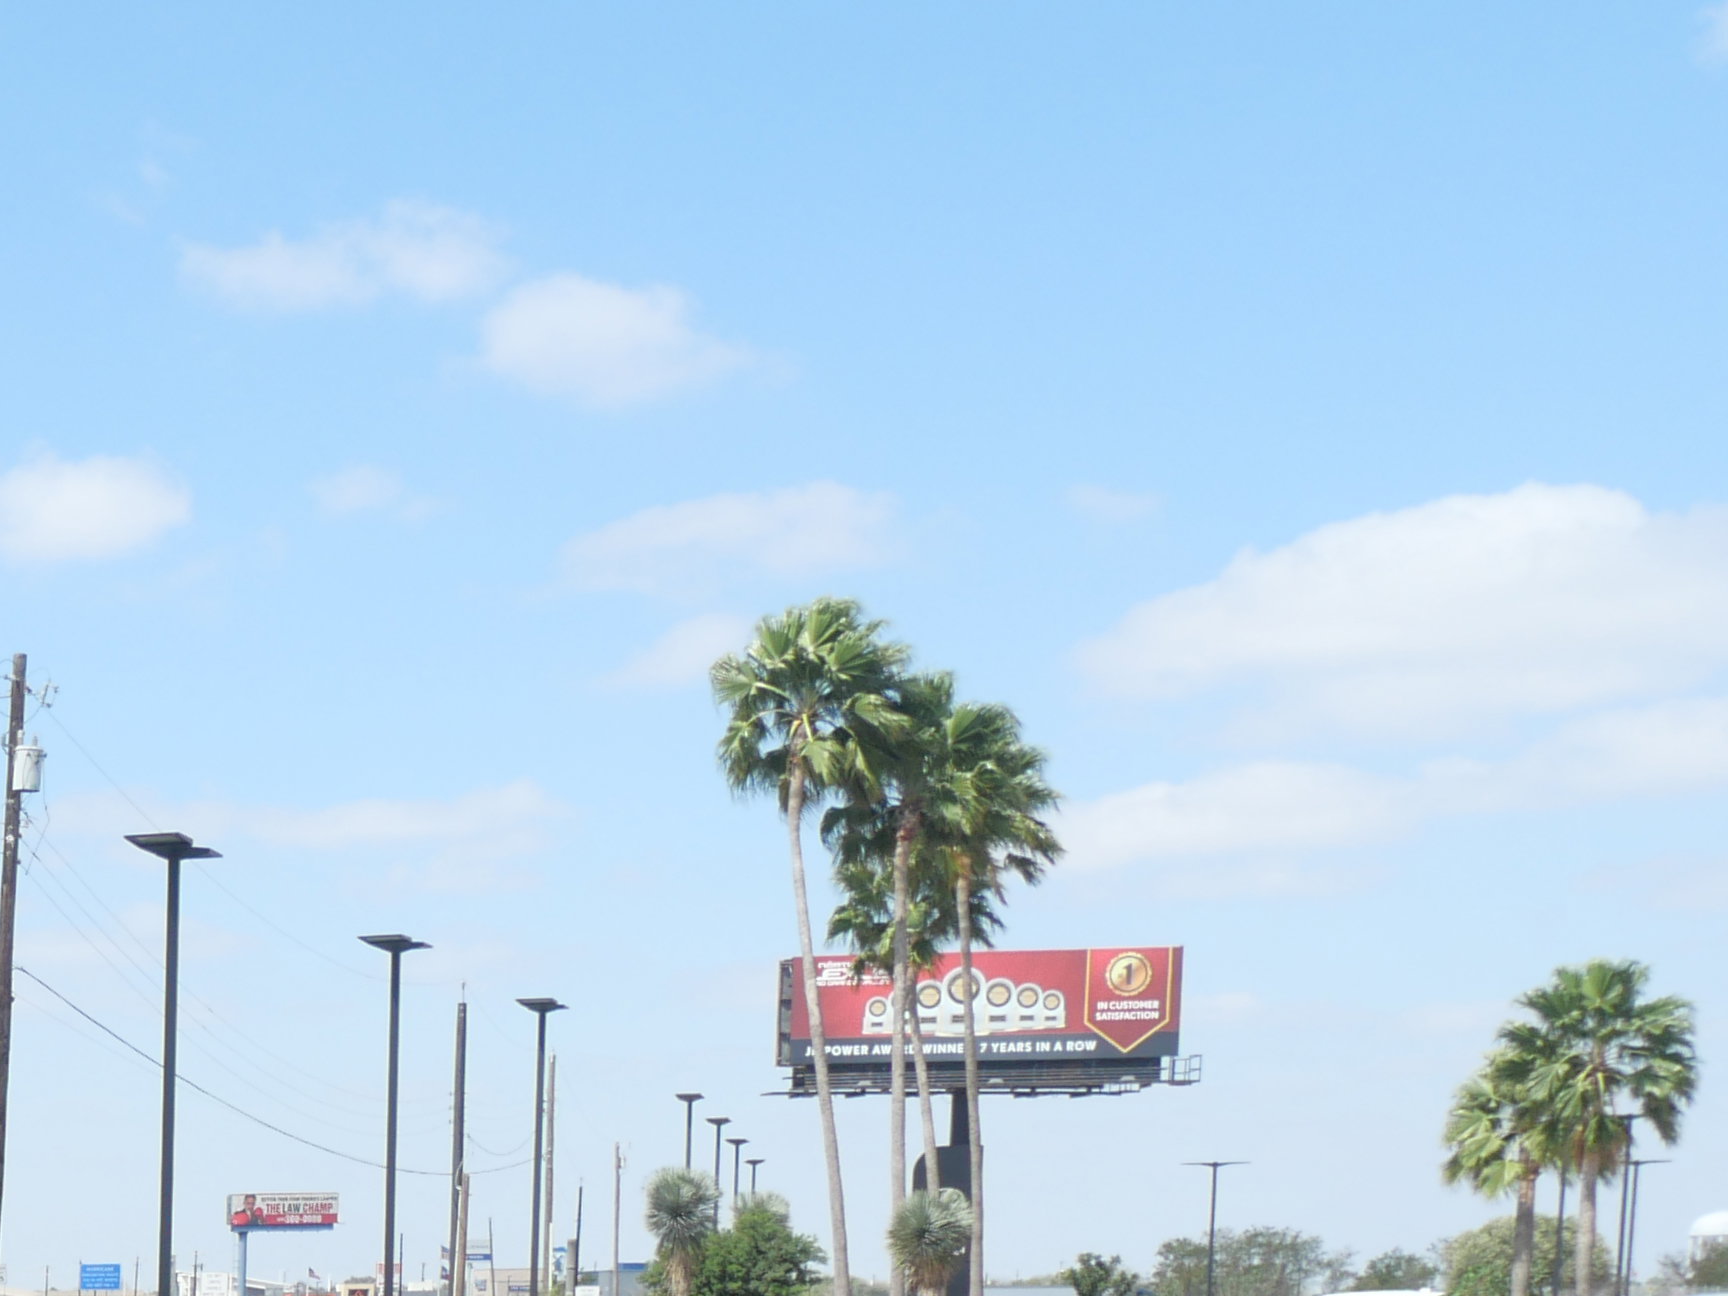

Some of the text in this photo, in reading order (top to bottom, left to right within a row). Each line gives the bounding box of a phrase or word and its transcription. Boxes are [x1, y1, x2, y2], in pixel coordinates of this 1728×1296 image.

[1097, 1000, 1159, 1010] IN CUSTOMER
[1096, 1011, 1159, 1021] SATISFACTION
[825, 1044, 869, 1056] POWER
[922, 1042, 964, 1054] WINNE
[980, 1043, 987, 1053] 7
[992, 1041, 1032, 1052] YEARS
[1036, 1040, 1050, 1051] IN
[1054, 1040, 1063, 1051] A
[1067, 1040, 1097, 1051] ROW
[266, 1202, 334, 1213] THE LAW CHAMP
